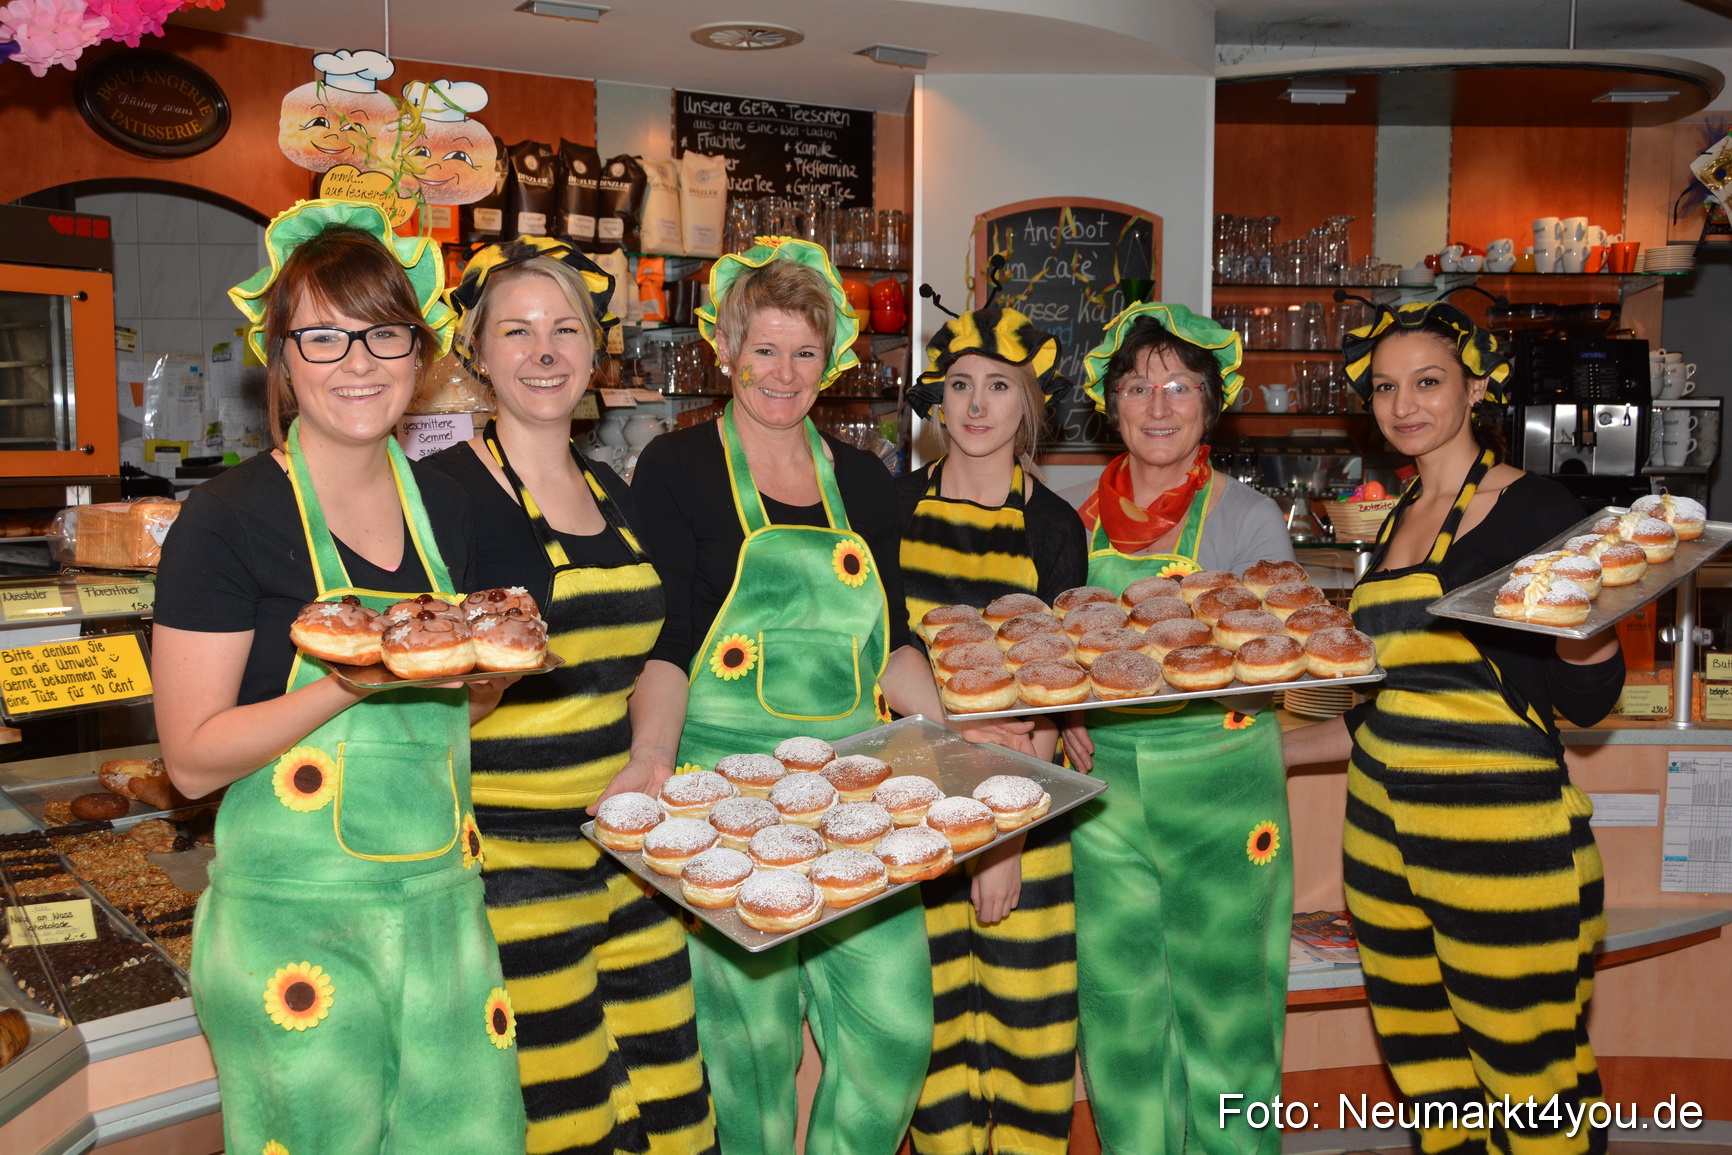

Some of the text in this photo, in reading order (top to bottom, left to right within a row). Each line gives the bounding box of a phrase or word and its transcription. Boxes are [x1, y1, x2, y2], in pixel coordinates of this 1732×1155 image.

[96, 69, 213, 117] BOULANGERIE
[683, 96, 735, 116] Unsere
[110, 108, 203, 140] PATISSERIE
[693, 119, 715, 129] aus
[719, 119, 743, 132] dem
[794, 141, 837, 158] Kamille
[794, 158, 858, 179] Pfefferminz
[518, 172, 549, 184] DINZLER
[600, 179, 631, 189] DINZLER
[754, 174, 776, 193] Tee
[325, 186, 343, 197] aus
[689, 187, 718, 196] DINZLER
[832, 181, 856, 199] Tee
[1024, 213, 1110, 248] Angebot
[403, 418, 456, 435] geschnittene
[419, 431, 453, 443] Semmel
[2, 590, 47, 602] Nusstaler
[83, 585, 140, 598] Florentiner
[131, 602, 149, 612] 1,50
[2, 640, 106, 664] Bitte denken Sie
[11, 655, 99, 676] an die Umwelt
[3, 666, 117, 692] Gerne bekommen Sie
[7, 677, 135, 708] eine Tüte für 10 Cent
[37, 914, 48, 922] an
[53, 911, 74, 920] Nuss
